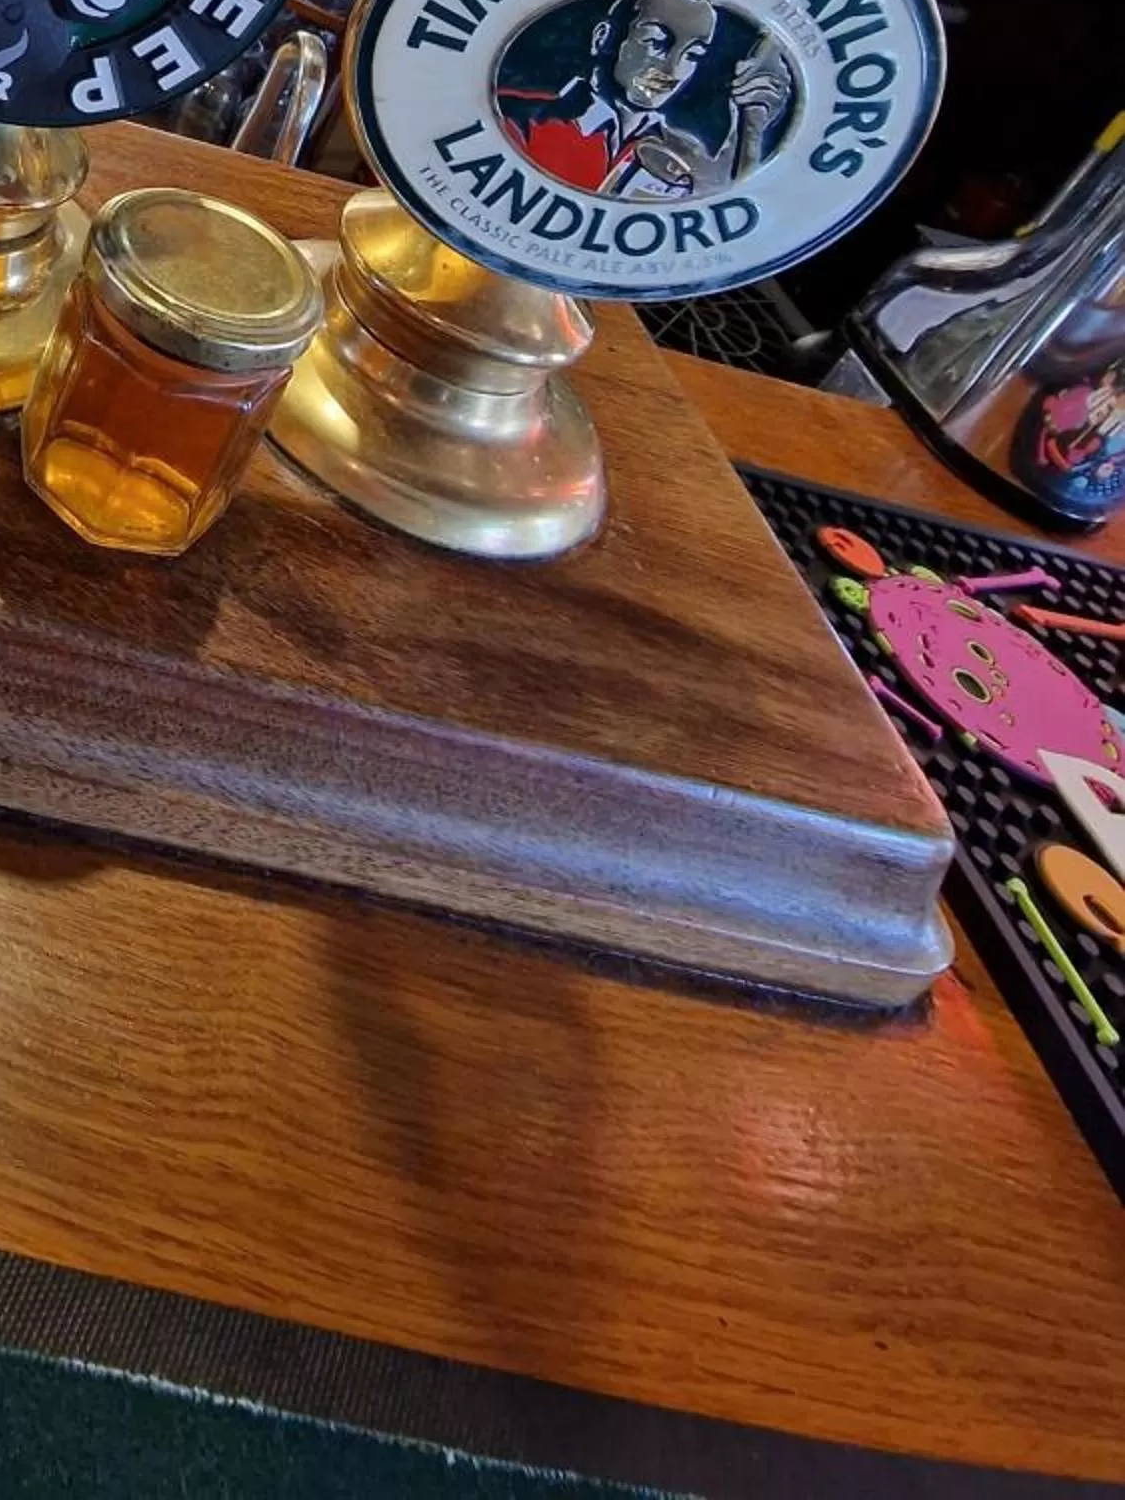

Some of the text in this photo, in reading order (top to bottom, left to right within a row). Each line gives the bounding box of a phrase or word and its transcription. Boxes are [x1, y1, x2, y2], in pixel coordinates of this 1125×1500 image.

[418, 166, 448, 197] THE
[450, 196, 521, 250] CLASSIC
[525, 242, 576, 267] PALE
[582, 255, 625, 275] ALE
[434, 119, 760, 258] LANDLORD
